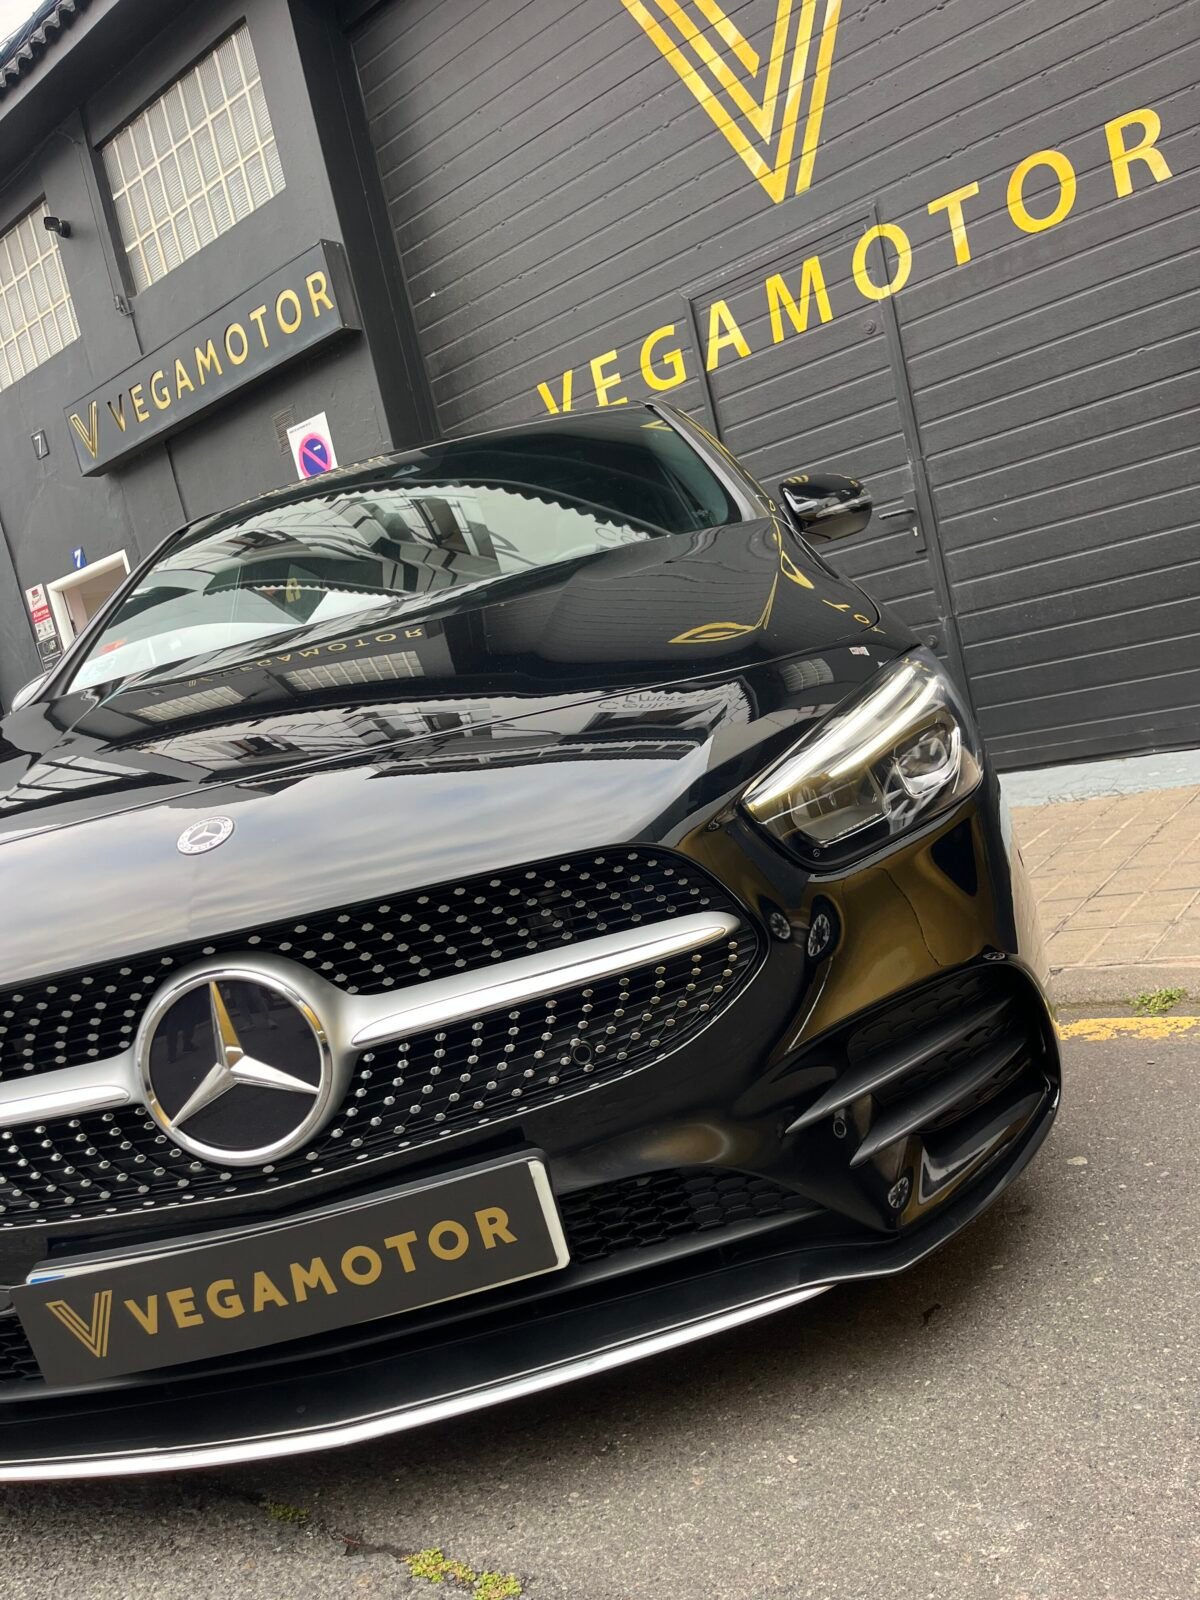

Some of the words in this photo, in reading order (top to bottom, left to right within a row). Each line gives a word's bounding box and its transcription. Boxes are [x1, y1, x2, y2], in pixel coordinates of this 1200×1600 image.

[537, 107, 1172, 415] VEGAMOTOR
[107, 271, 335, 433] VEGAMOTOR
[74, 548, 82, 569] 7
[124, 1206, 518, 1335] VEGAMOTOR
